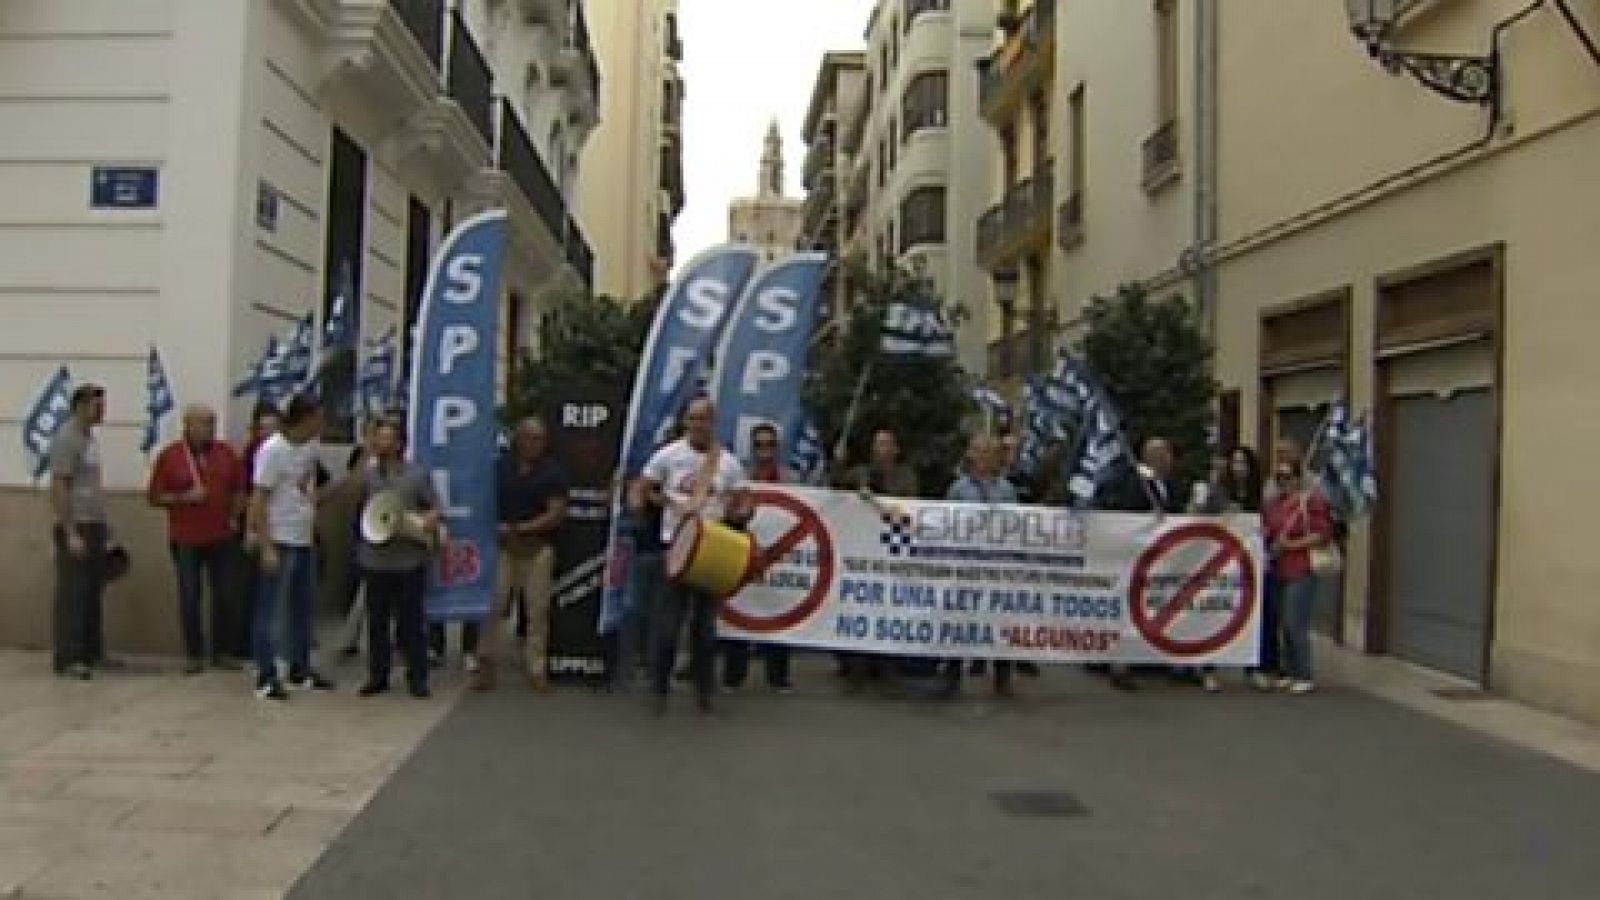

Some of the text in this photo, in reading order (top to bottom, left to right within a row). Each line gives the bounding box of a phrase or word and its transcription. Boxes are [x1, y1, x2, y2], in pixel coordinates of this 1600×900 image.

[562, 406, 609, 428] RIP
[839, 579, 884, 605] POR
[891, 582, 935, 608] UNA
[943, 586, 982, 611] LEY
[990, 588, 1044, 614] PARA
[1053, 593, 1121, 619] TODOS
[836, 615, 868, 639] NO
[876, 618, 934, 643] SOLO
[940, 621, 993, 645] PARA
